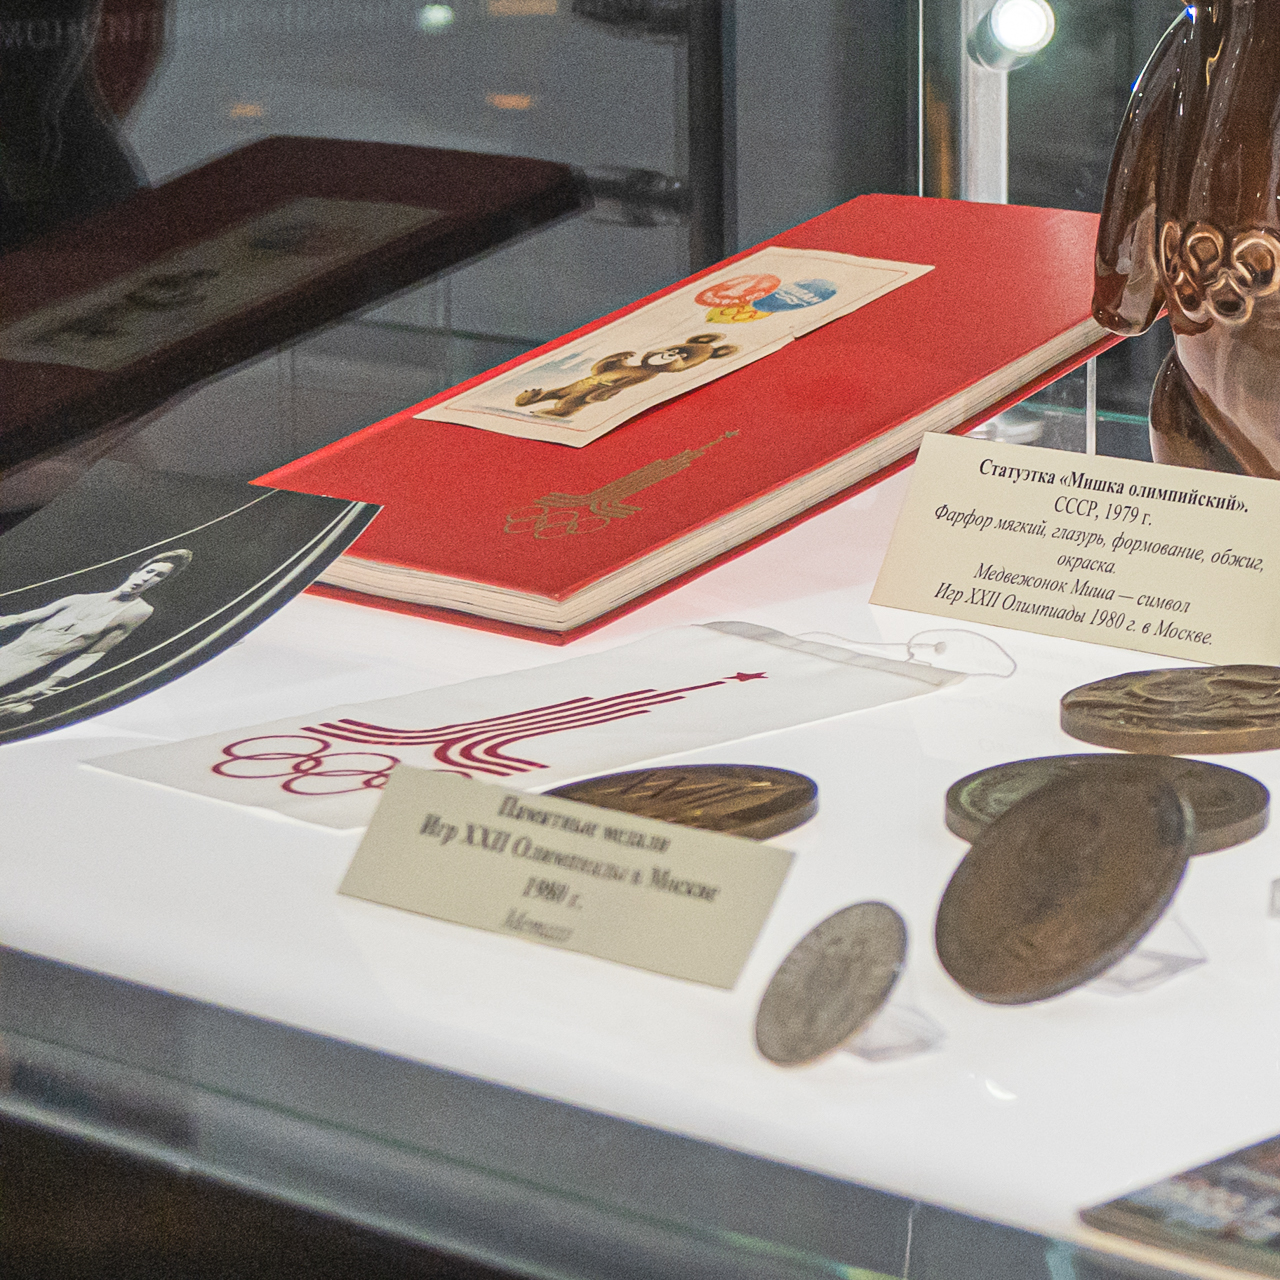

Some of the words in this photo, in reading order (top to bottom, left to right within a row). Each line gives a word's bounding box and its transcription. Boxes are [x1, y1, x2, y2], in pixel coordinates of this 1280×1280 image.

[979, 458, 1056, 485] Статуэтка
[1059, 471, 1125, 496] «Мишка
[1129, 484, 1249, 513] олимпийский».
[1054, 495, 1099, 521] СССР,
[1105, 503, 1139, 524] 1979
[1141, 512, 1152, 526] г.
[934, 504, 994, 531] Фарфор
[994, 519, 1048, 539] мягкий,
[1051, 526, 1107, 549] глазурь,
[1111, 531, 1205, 564] формование,
[1210, 548, 1265, 573] обжиг,
[1057, 554, 1116, 575] окраска.
[934, 582, 964, 605] Игр
[964, 587, 1002, 608] XXII
[1001, 594, 1086, 624] Олимпиады
[1089, 608, 1126, 630] 1980
[1126, 619, 1136, 632] г.
[1141, 621, 1152, 634] в
[1153, 619, 1213, 646] Москве.
[973, 562, 1068, 593] Медвежонок
[1070, 578, 1116, 601] Миша
[1136, 593, 1191, 613] символ
